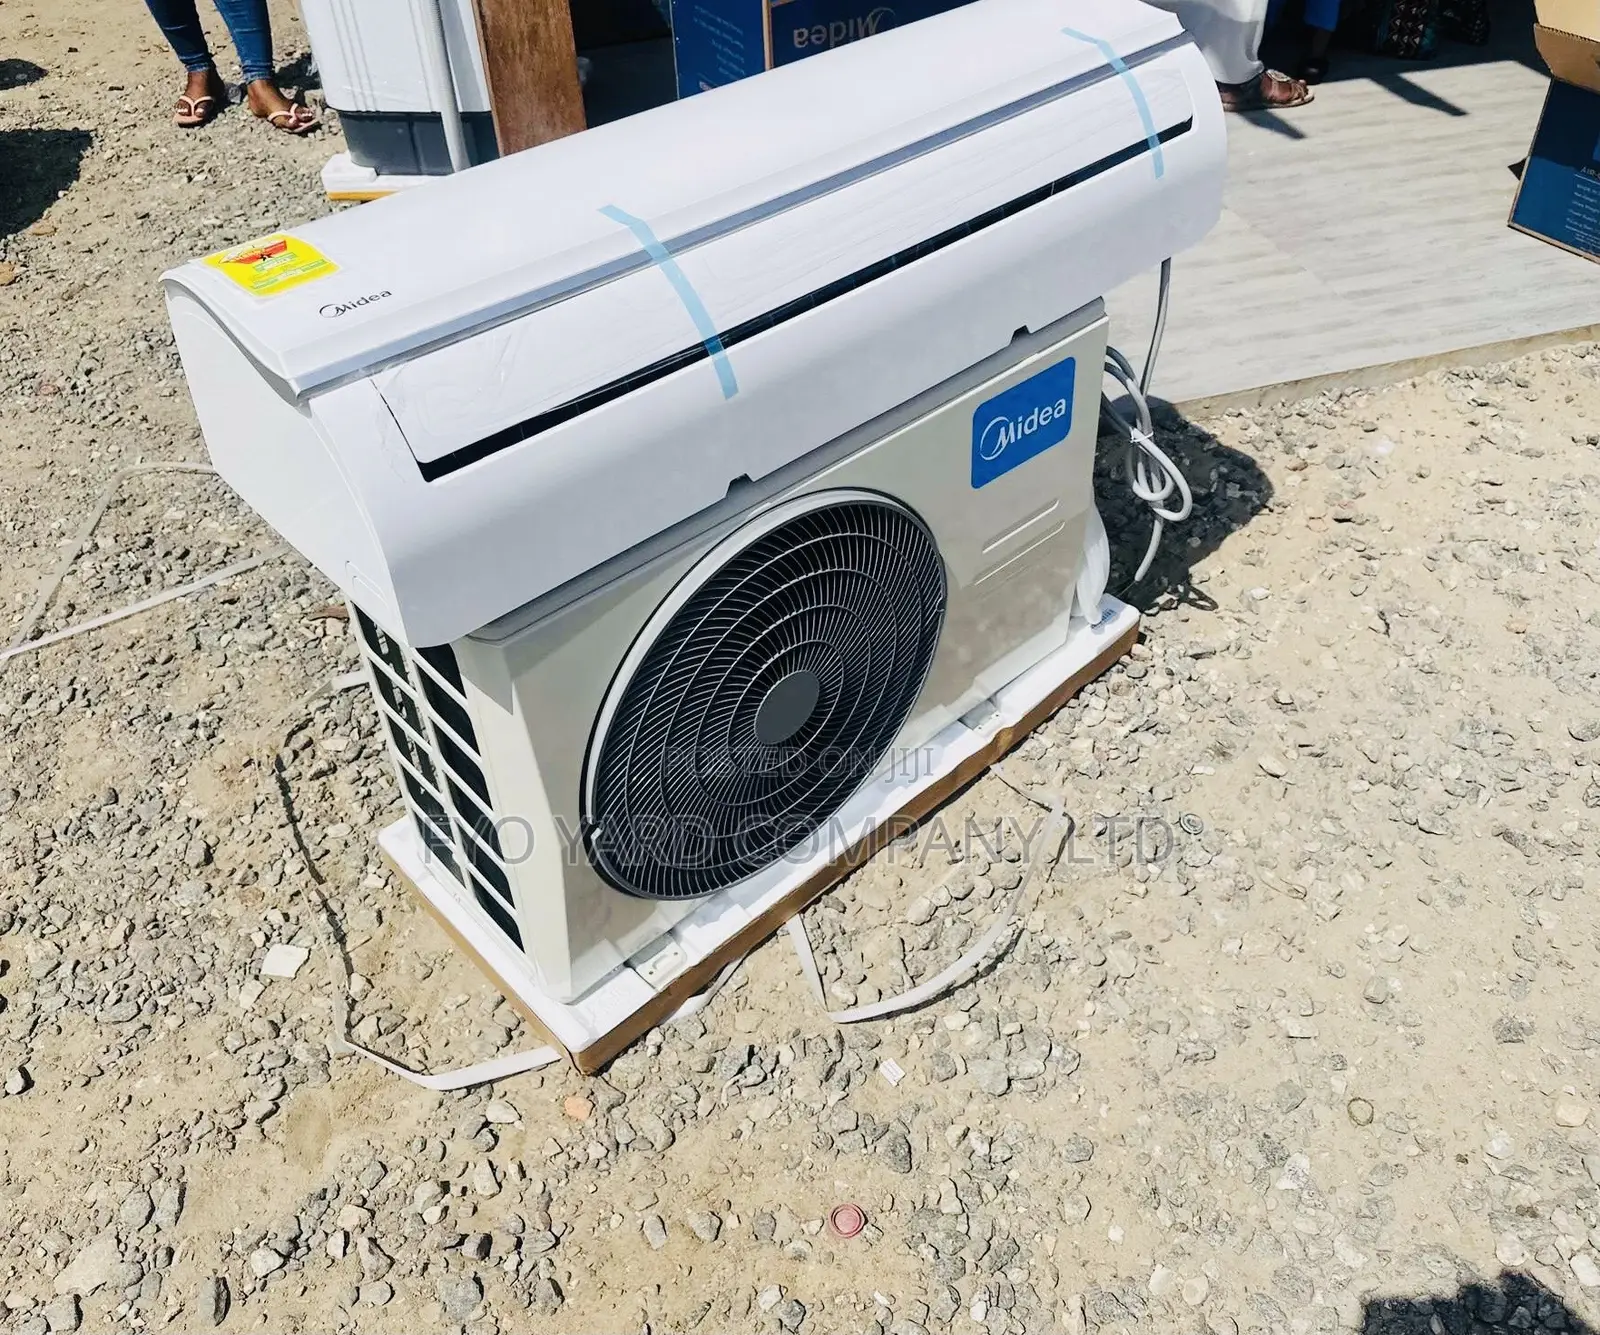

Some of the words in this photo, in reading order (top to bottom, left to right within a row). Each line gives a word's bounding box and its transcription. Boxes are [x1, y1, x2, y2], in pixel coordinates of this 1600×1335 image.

[793, 7, 896, 48] Midea
[319, 289, 392, 318] Midea
[980, 398, 1066, 460] Midea
